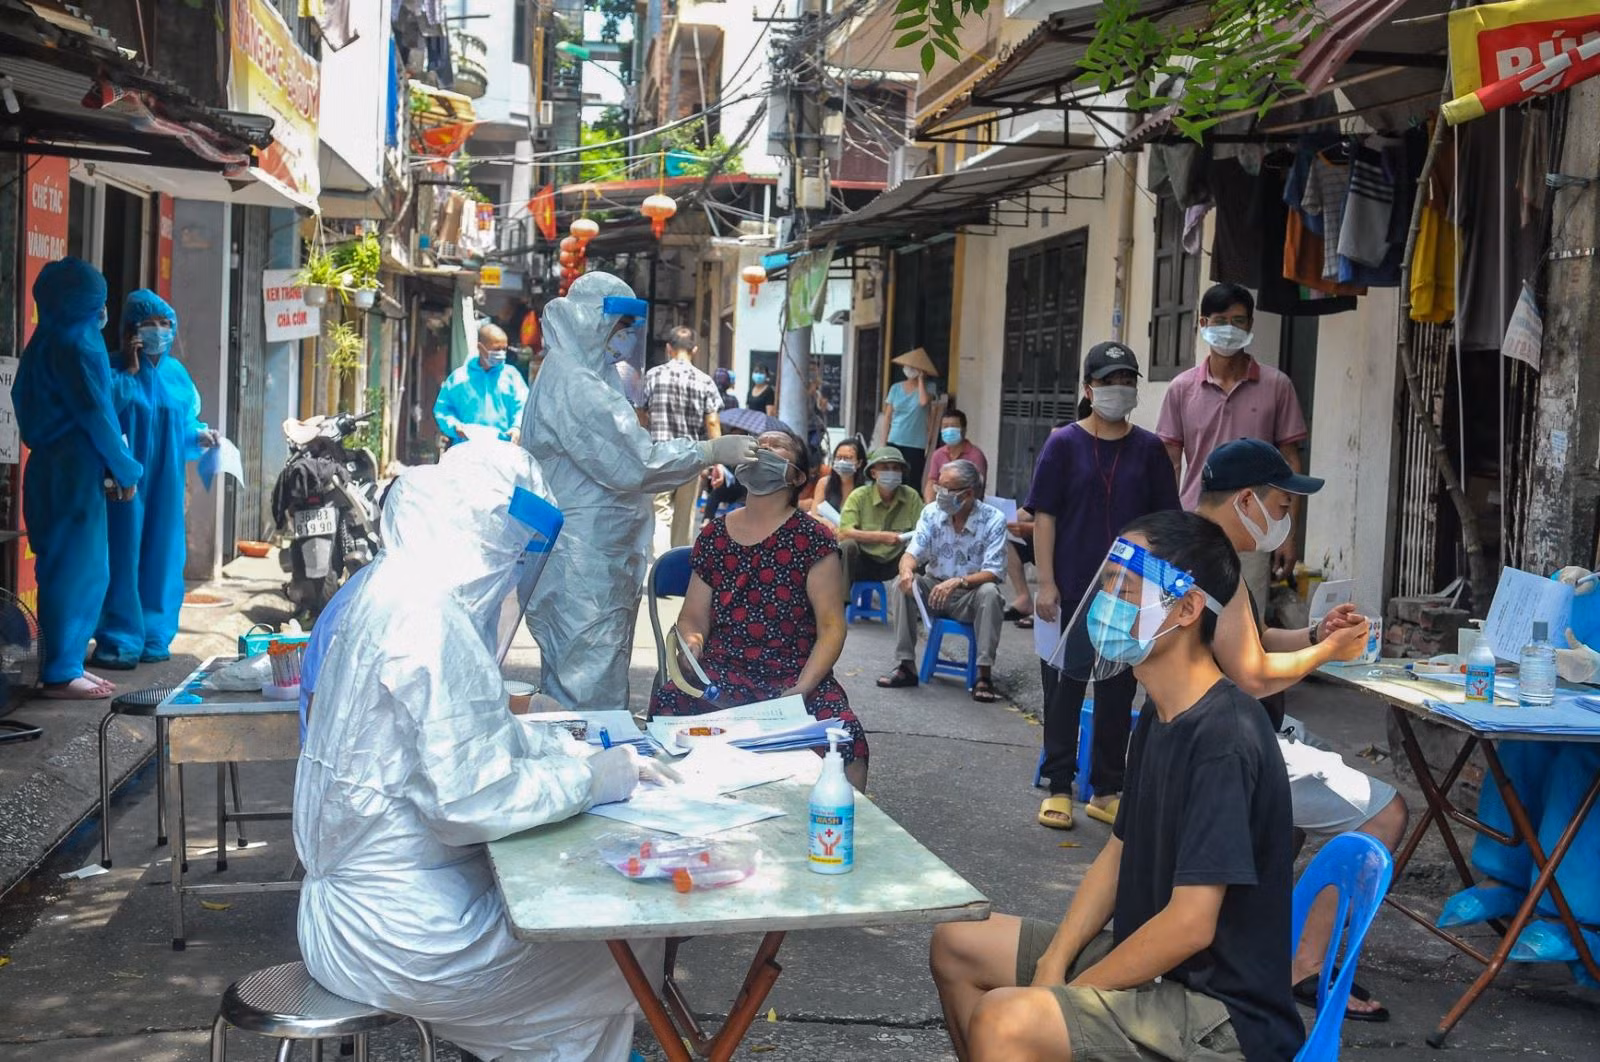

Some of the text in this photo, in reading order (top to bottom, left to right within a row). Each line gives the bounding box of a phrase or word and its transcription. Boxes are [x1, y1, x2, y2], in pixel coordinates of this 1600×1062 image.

[32, 175, 64, 215] CHẾ TÁC
[28, 224, 50, 260] VÀNG
